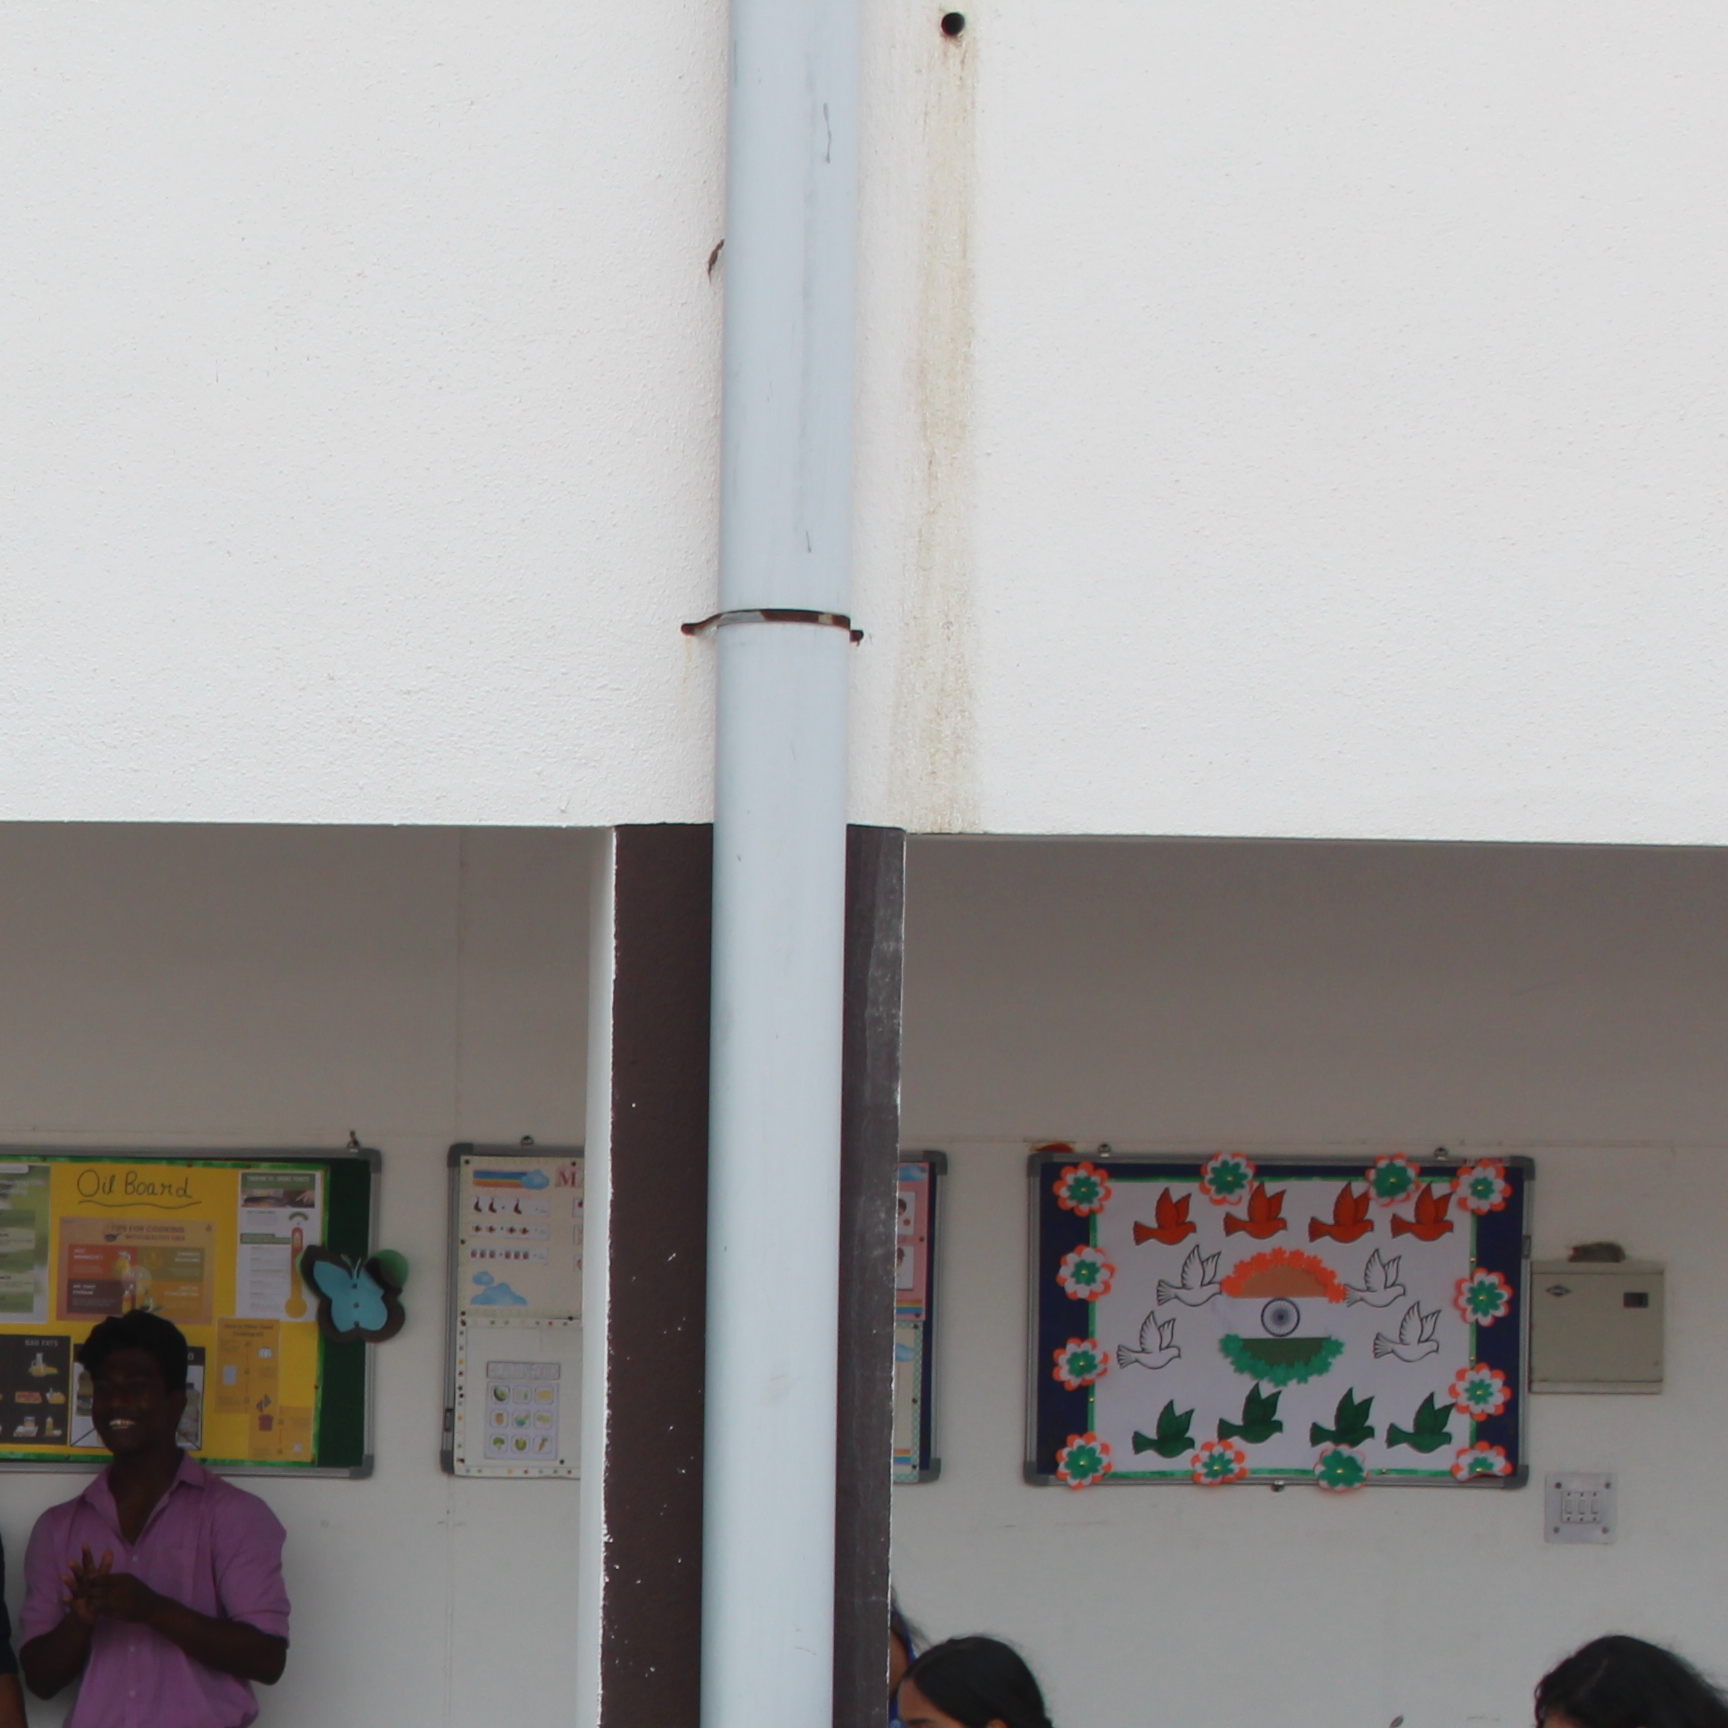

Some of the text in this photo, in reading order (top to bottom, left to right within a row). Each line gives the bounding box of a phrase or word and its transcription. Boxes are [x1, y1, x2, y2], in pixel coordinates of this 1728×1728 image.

[77, 1169, 193, 1198] Oil Board
[41, 1339, 58, 1347] FATS
